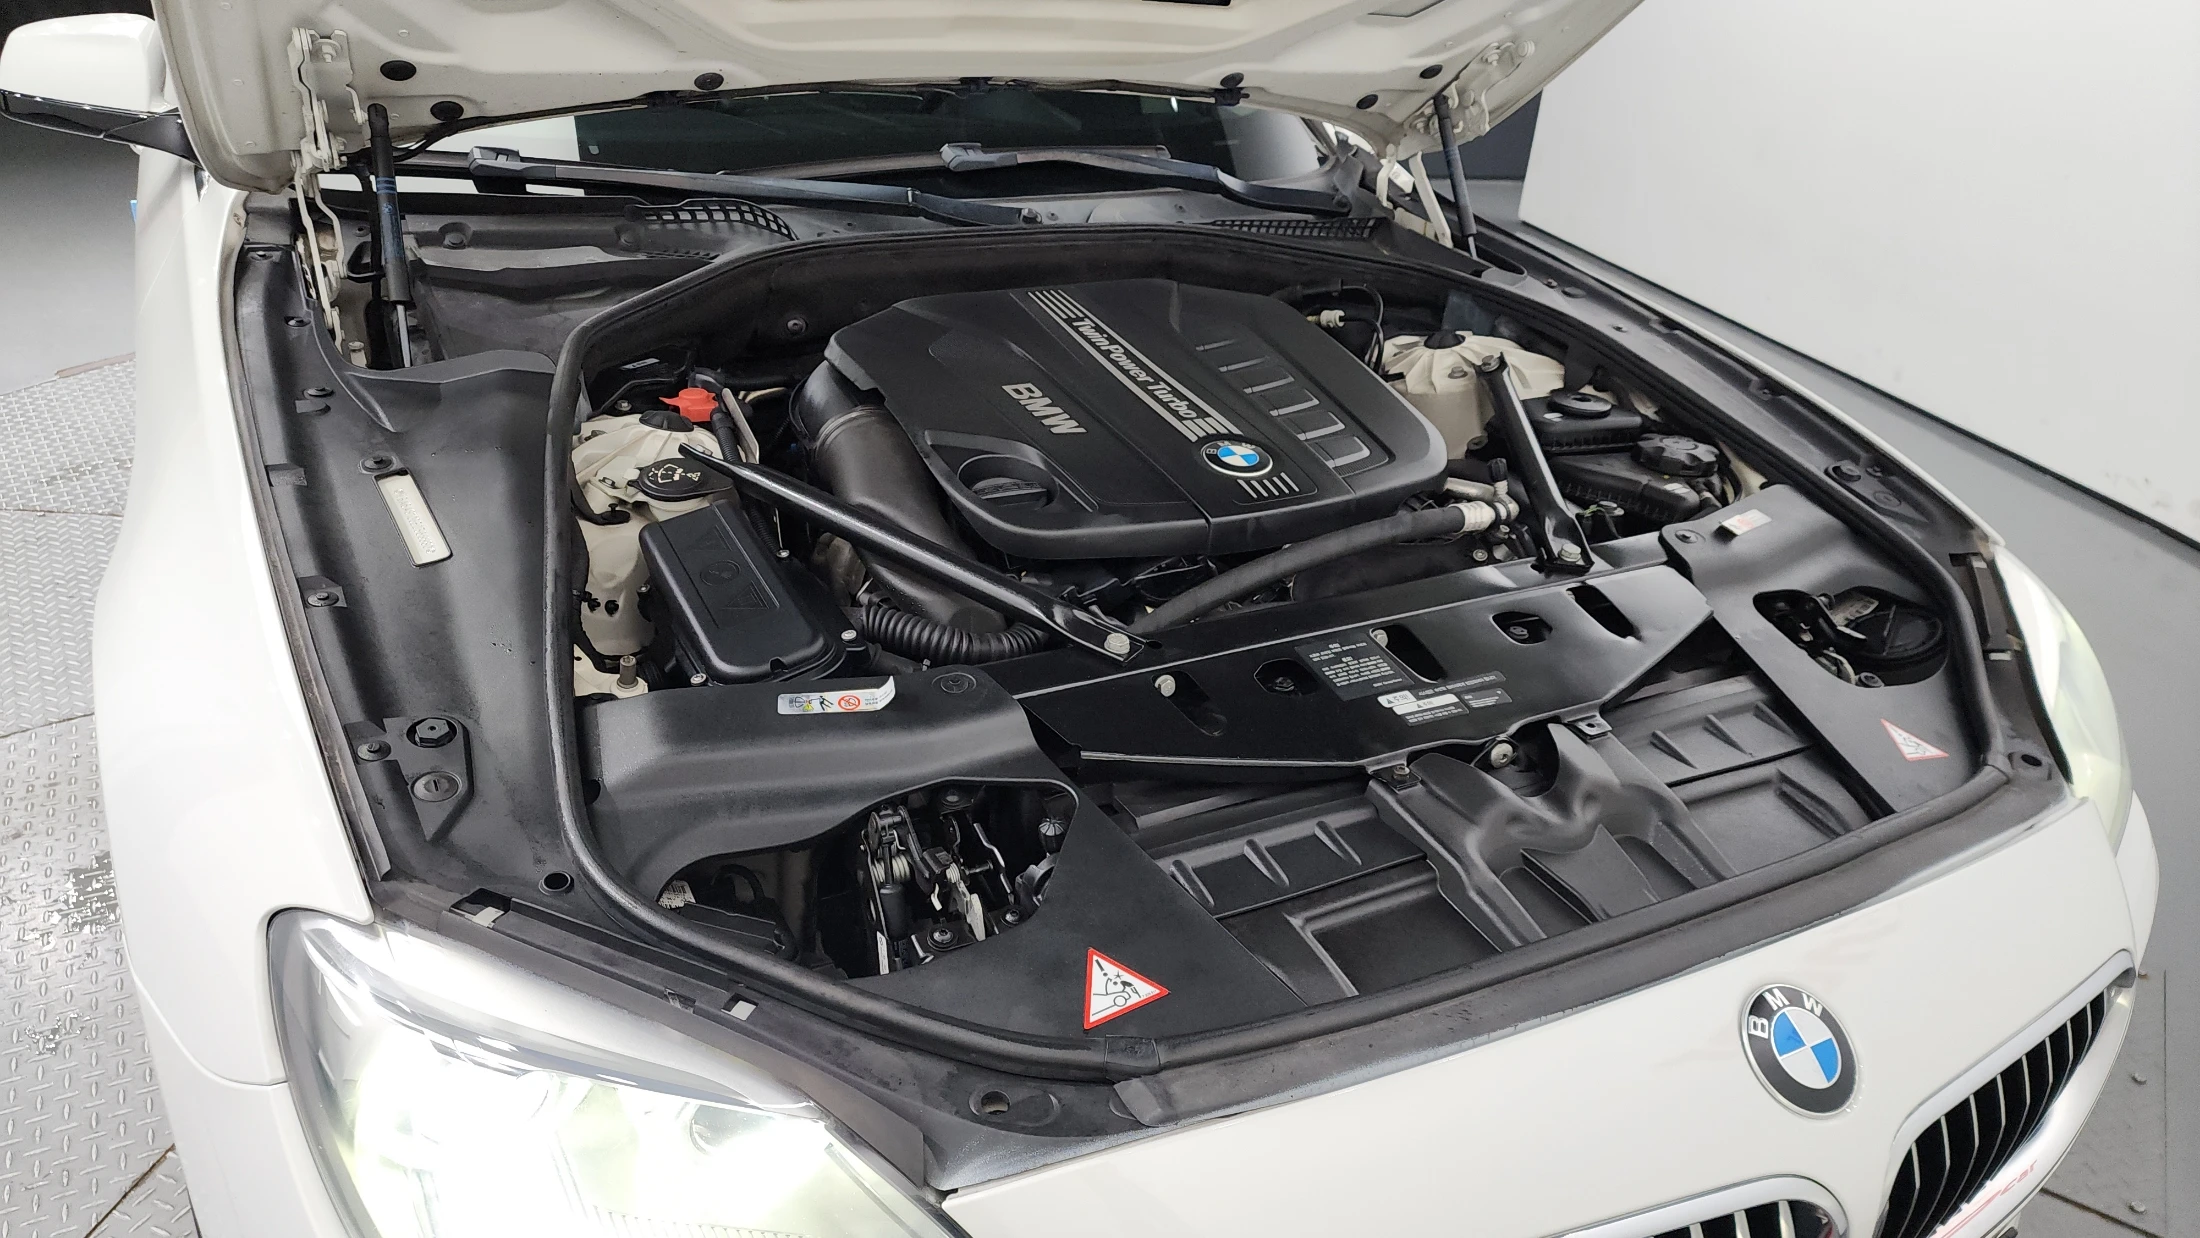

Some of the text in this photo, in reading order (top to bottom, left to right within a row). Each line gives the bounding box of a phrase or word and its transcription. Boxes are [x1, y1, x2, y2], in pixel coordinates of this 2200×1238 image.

[1072, 318, 1198, 418] TwinPower Turbo
[1001, 382, 1088, 434] BMW
[1206, 440, 1256, 455] BMW
[1747, 987, 1823, 1040] BMW
